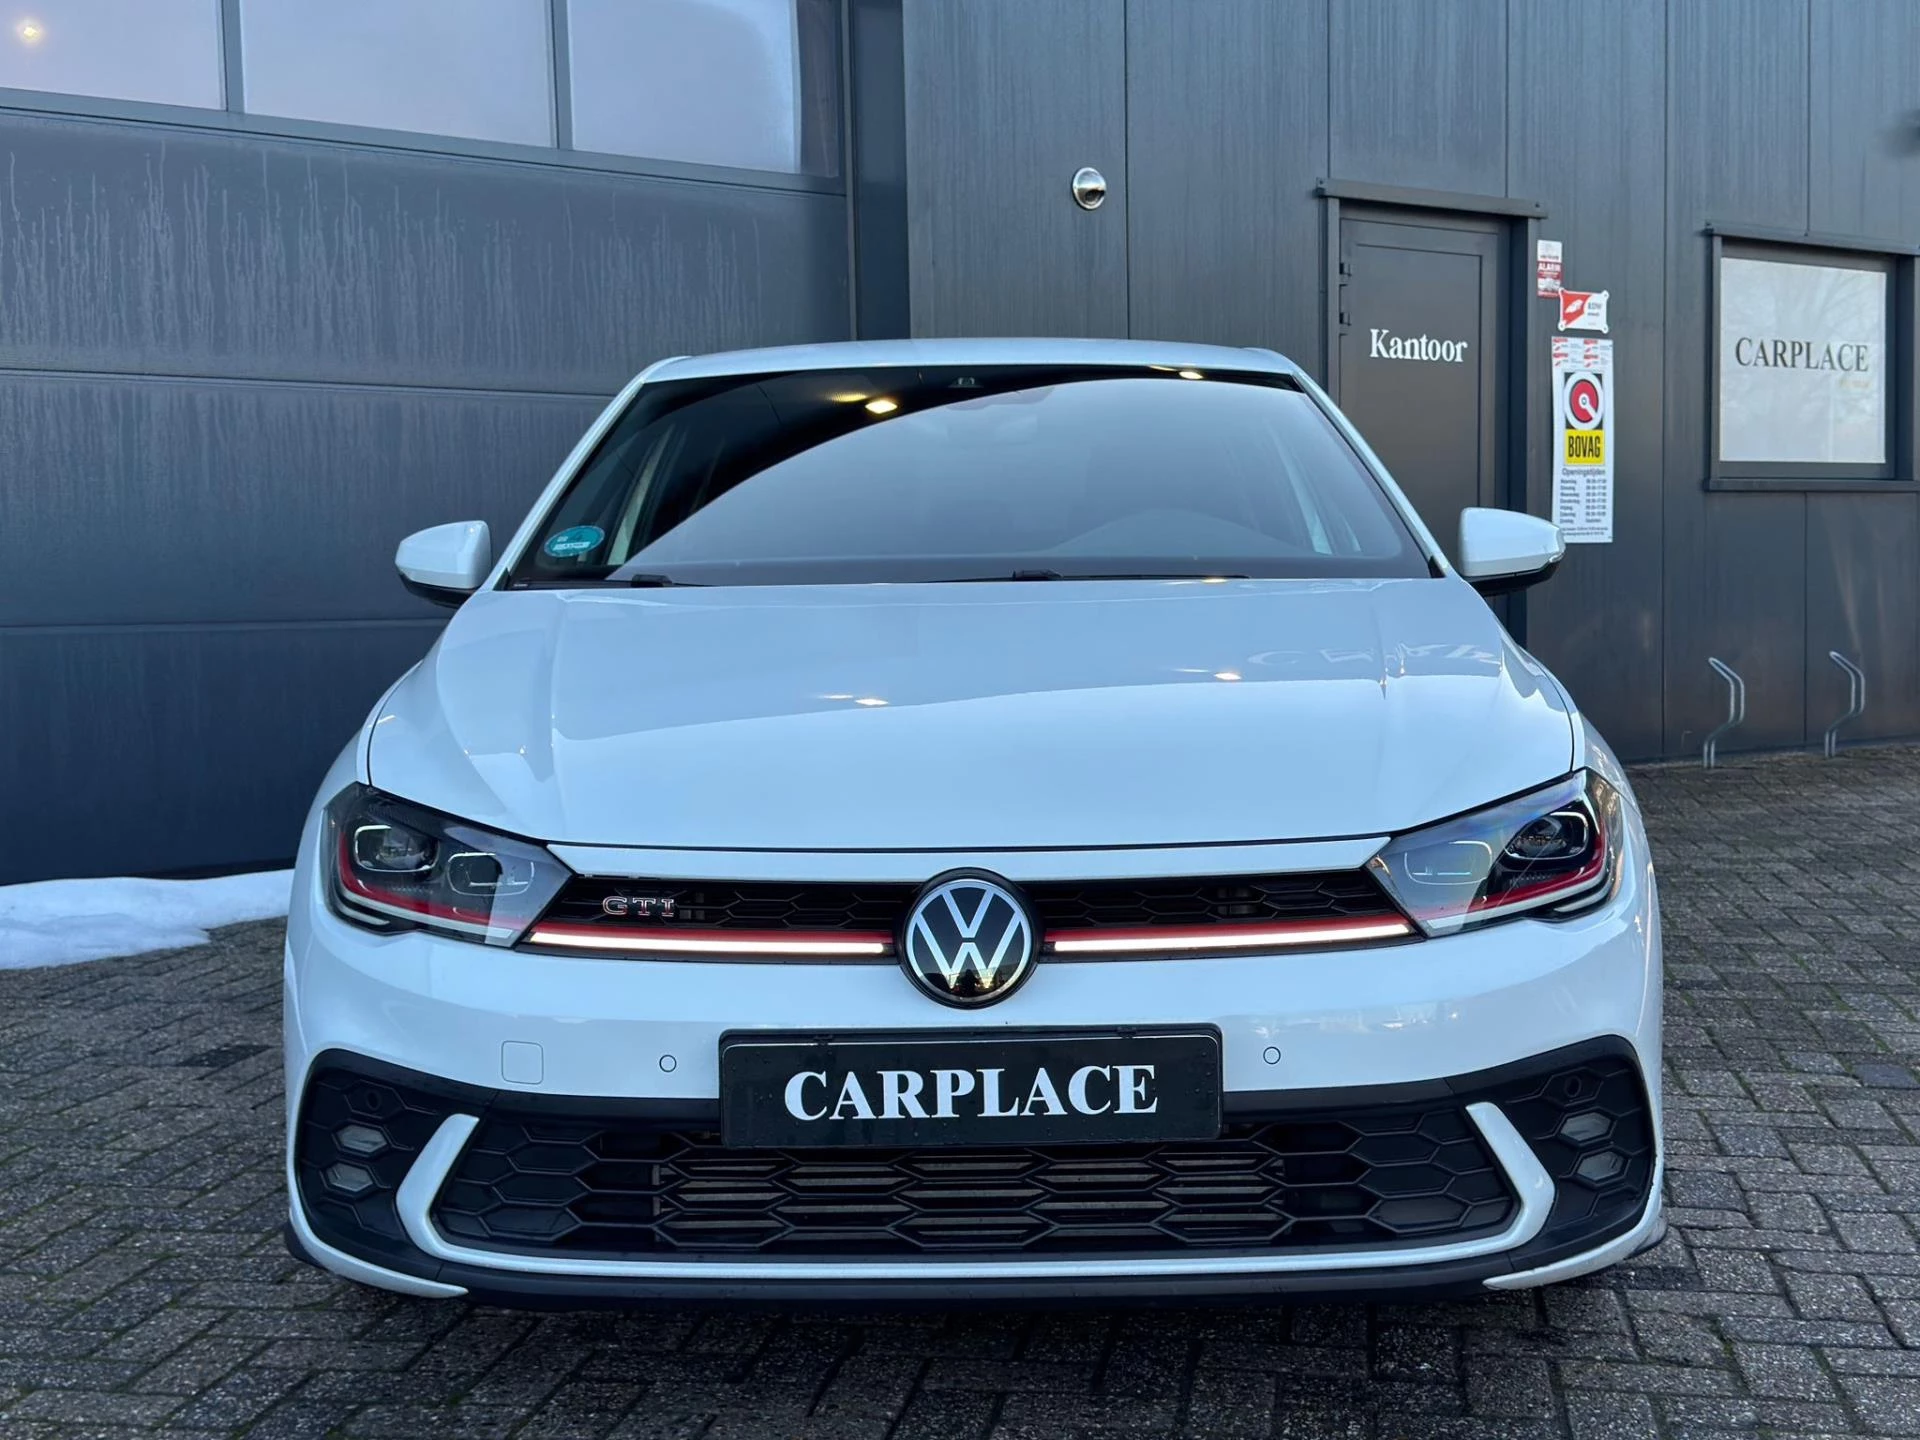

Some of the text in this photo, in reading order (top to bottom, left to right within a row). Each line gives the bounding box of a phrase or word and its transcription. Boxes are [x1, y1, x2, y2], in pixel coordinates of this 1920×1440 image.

[1369, 328, 1468, 363] Kantoor
[1735, 337, 1869, 372] CARPLACE
[1568, 435, 1601, 458] BOVAG
[602, 895, 674, 917] GTI
[784, 1064, 1158, 1121] CARPLACE
